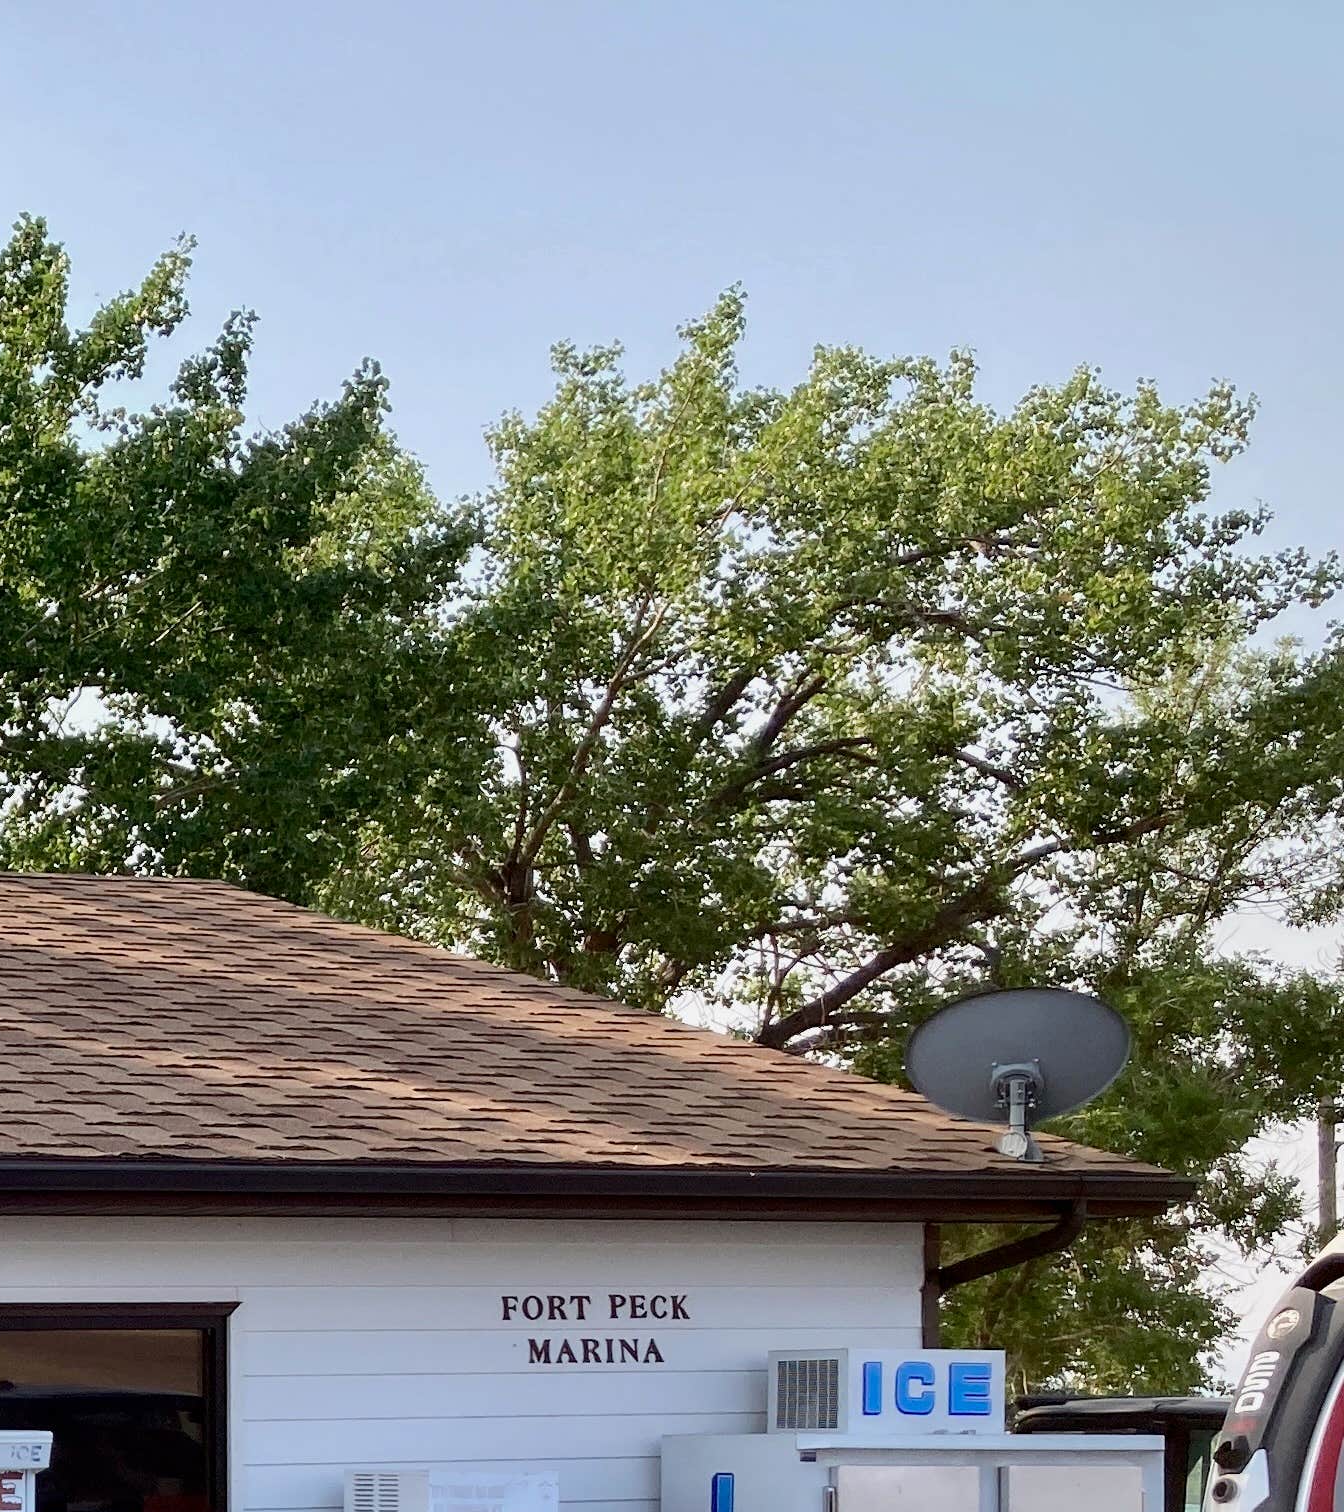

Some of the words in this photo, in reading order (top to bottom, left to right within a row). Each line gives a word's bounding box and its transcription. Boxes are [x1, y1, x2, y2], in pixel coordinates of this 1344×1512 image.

[501, 1295, 592, 1321] FORT
[608, 1294, 692, 1320] PECK
[527, 1338, 666, 1364] MARINA
[862, 1361, 994, 1416] ICE
